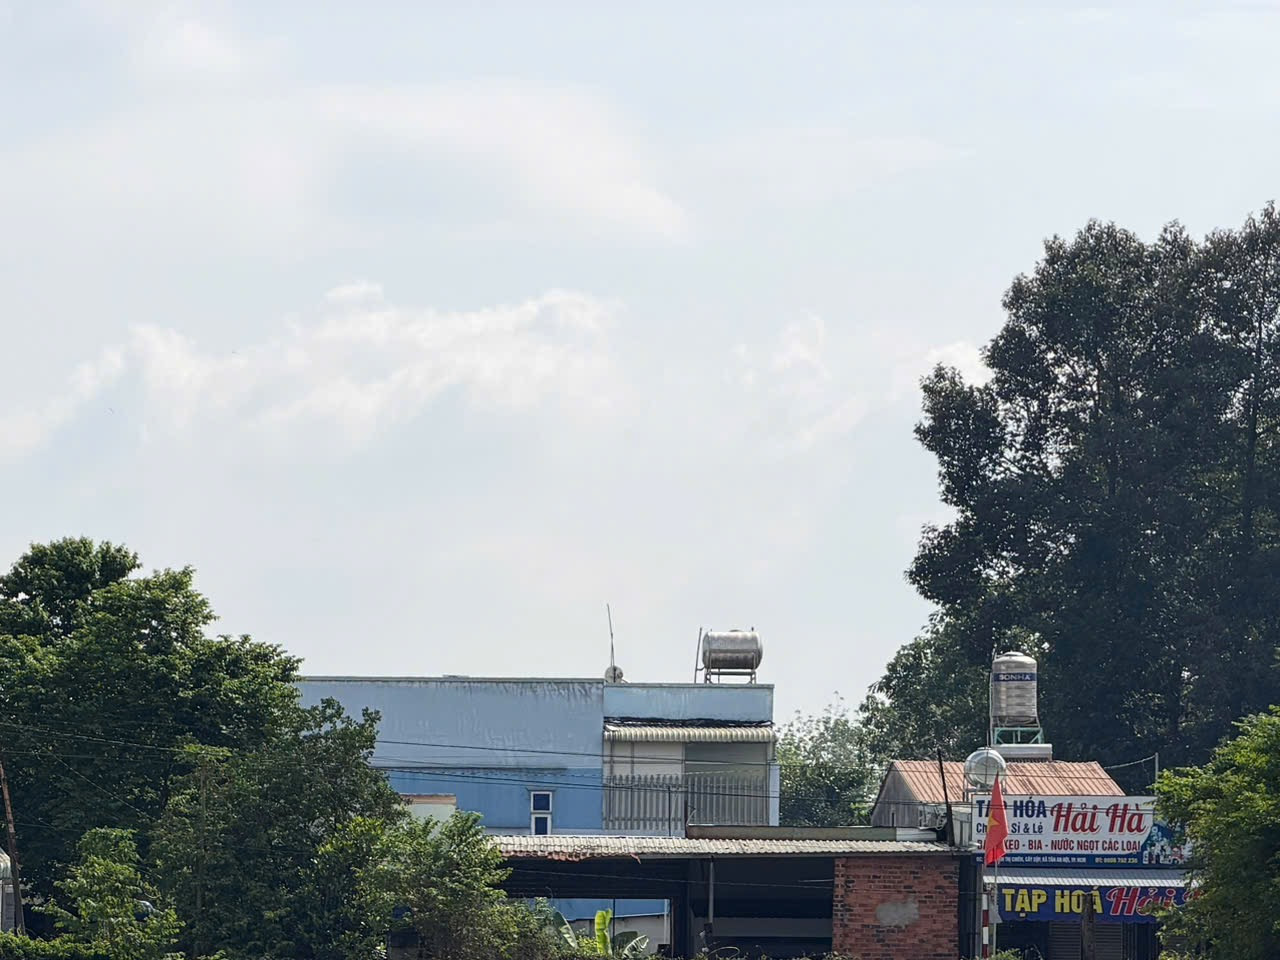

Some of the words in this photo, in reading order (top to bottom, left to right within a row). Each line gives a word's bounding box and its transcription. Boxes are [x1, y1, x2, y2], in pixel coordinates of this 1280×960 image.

[1013, 796, 1047, 818] HÓA
[1050, 802, 1100, 834] Hải
[1105, 803, 1147, 834] Hà
[1023, 823, 1030, 833] &
[1028, 840, 1042, 850] BIA
[1077, 840, 1099, 853] NGỌT
[1102, 838, 1119, 851] CÁC
[1002, 888, 1047, 917] TẠP
